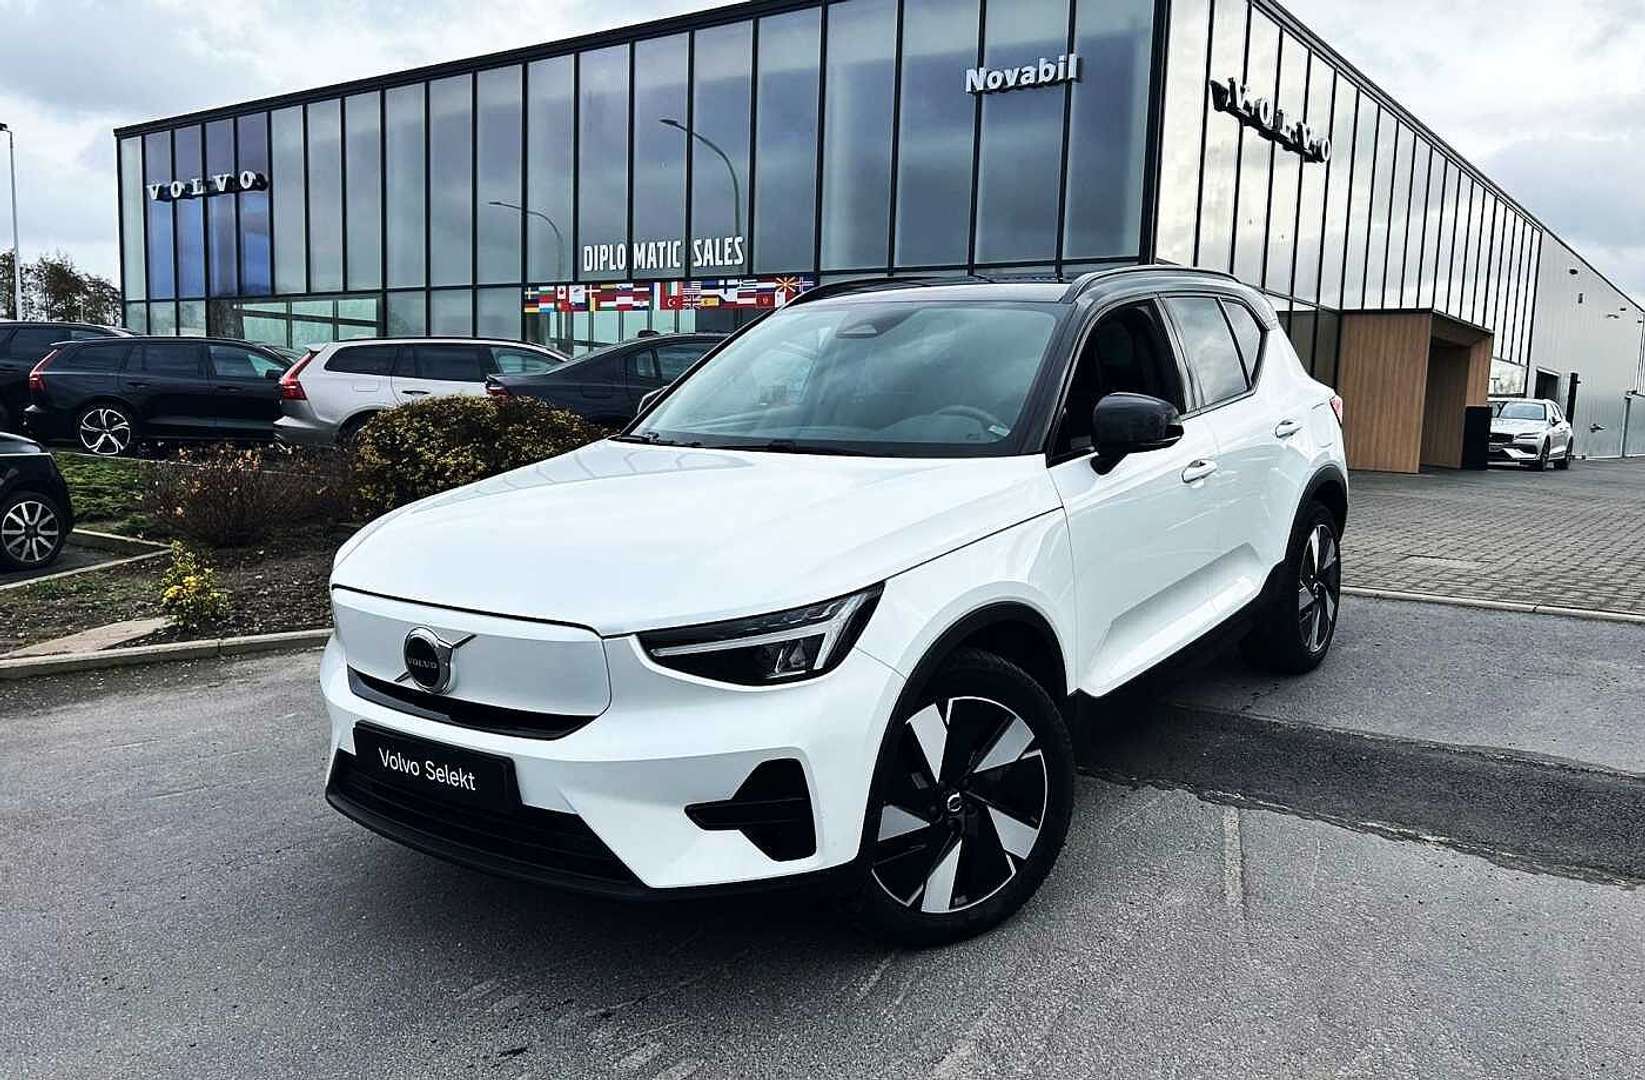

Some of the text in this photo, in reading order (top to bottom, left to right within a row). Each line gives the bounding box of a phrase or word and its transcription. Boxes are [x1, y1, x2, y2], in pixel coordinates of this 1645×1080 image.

[965, 53, 1077, 92] Novabil
[146, 170, 258, 200] VOLVO
[693, 236, 744, 266] SALES
[407, 656, 438, 669] VOLVO
[378, 747, 476, 791] Volvo Selekt
